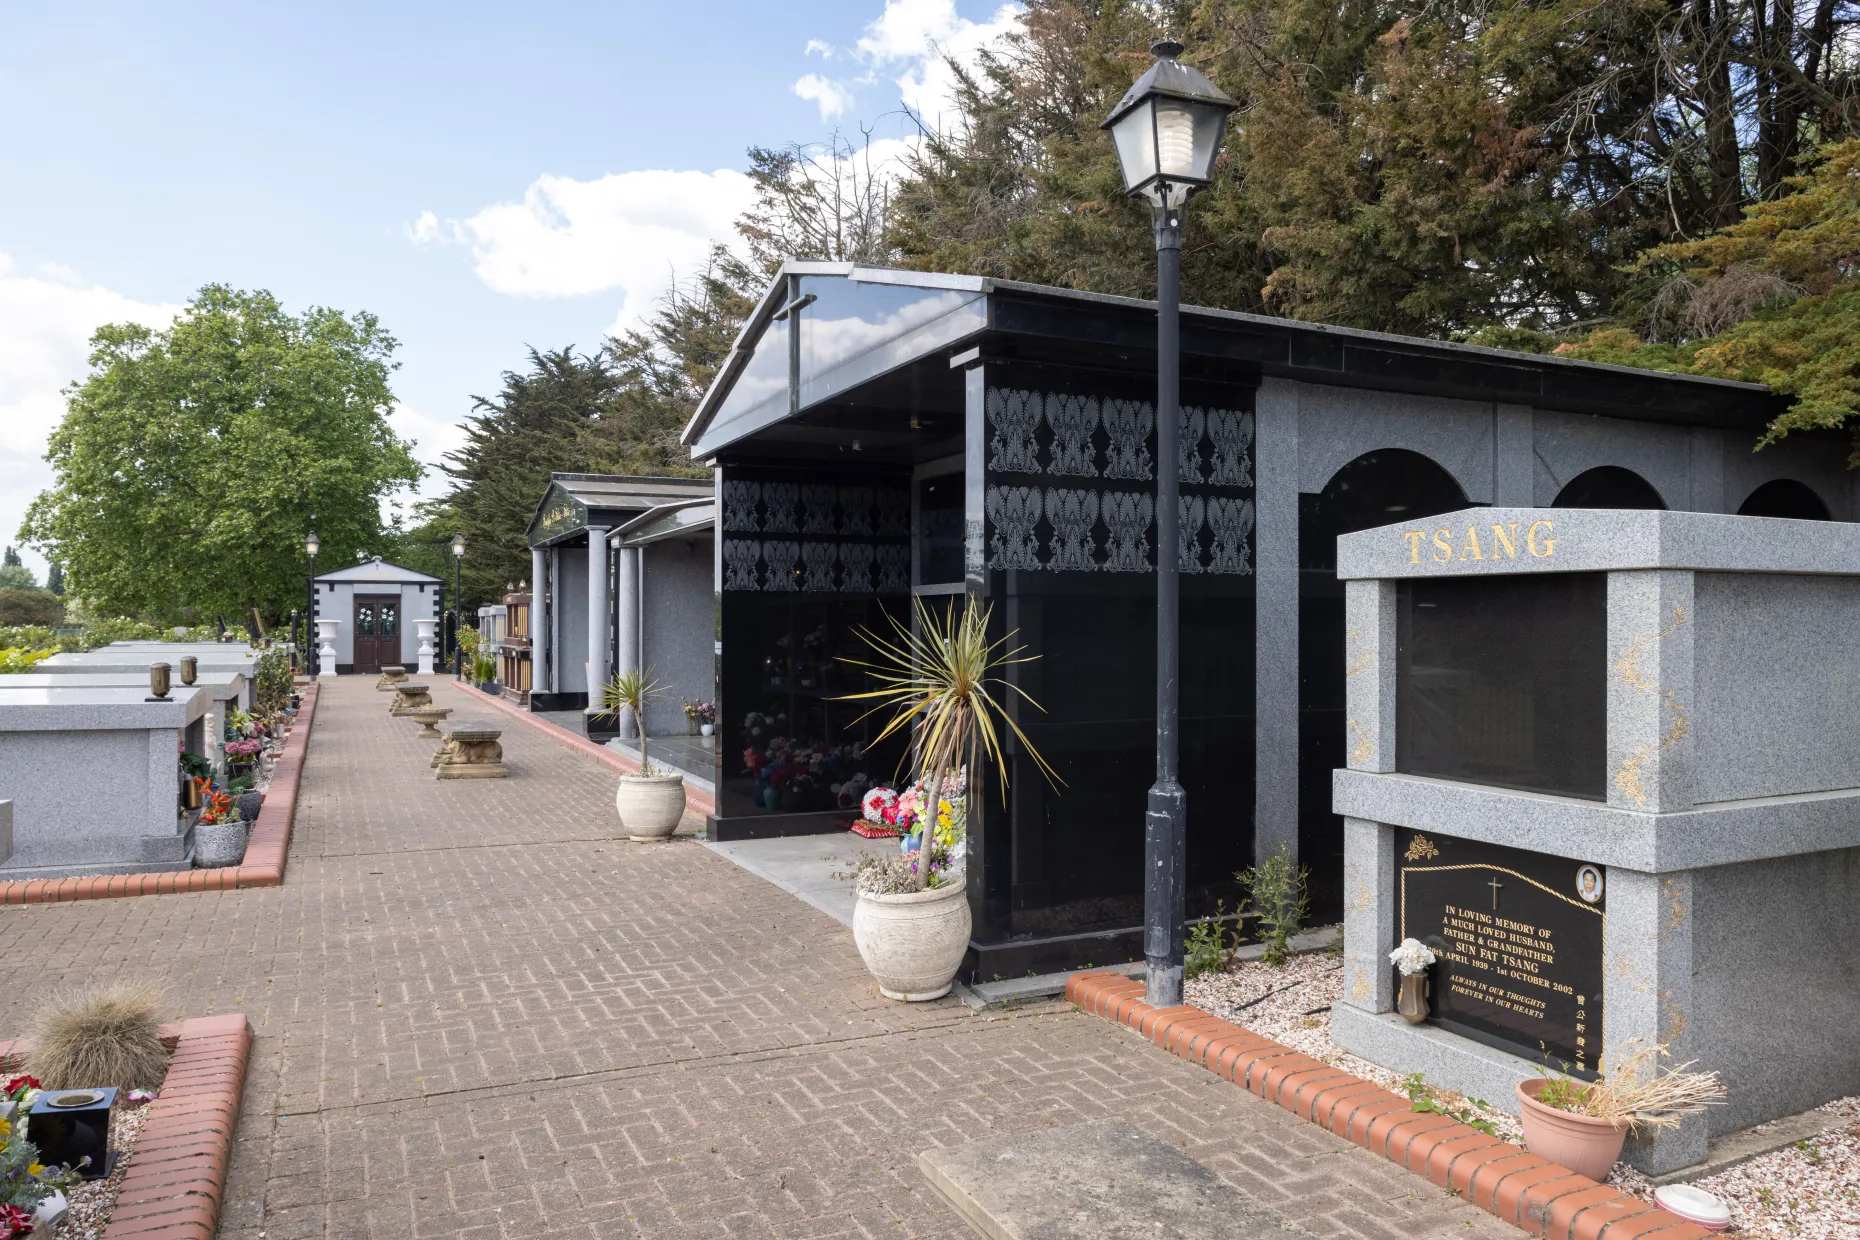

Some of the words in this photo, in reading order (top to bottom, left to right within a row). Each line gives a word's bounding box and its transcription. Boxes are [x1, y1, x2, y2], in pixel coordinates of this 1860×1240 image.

[1404, 519, 1556, 564] TSANG
[1446, 905, 1455, 914] IN
[1459, 908, 1492, 924] LOVING
[1495, 918, 1535, 935] MEMORY
[1539, 929, 1551, 939] OF
[1451, 918, 1475, 931] MUCH
[1478, 925, 1506, 939] LOVED
[1510, 933, 1555, 953] HUSBAND,
[1444, 927, 1475, 942] FATHER
[1478, 937, 1484, 945] &
[1488, 939, 1553, 964] GRANDFATHER
[1456, 942, 1476, 955] SUN
[1480, 948, 1498, 962] FAT
[1502, 954, 1539, 973] TSANG
[1446, 952, 1469, 964] APRIL
[1472, 960, 1488, 970] 1939
[1497, 967, 1507, 975] 1st
[1511, 971, 1550, 988] OCTOBER
[1553, 983, 1573, 995] 2002
[1450, 975, 1476, 987] ALWAYS
[1479, 983, 1487, 991] IN
[1489, 987, 1504, 996] OUR
[1506, 992, 1546, 1008] THOUGHTS
[1451, 984, 1483, 1000] FOREVER
[1485, 995, 1493, 1003] IN
[1496, 999, 1510, 1009] OUR
[1513, 1004, 1544, 1019] HEARTS
